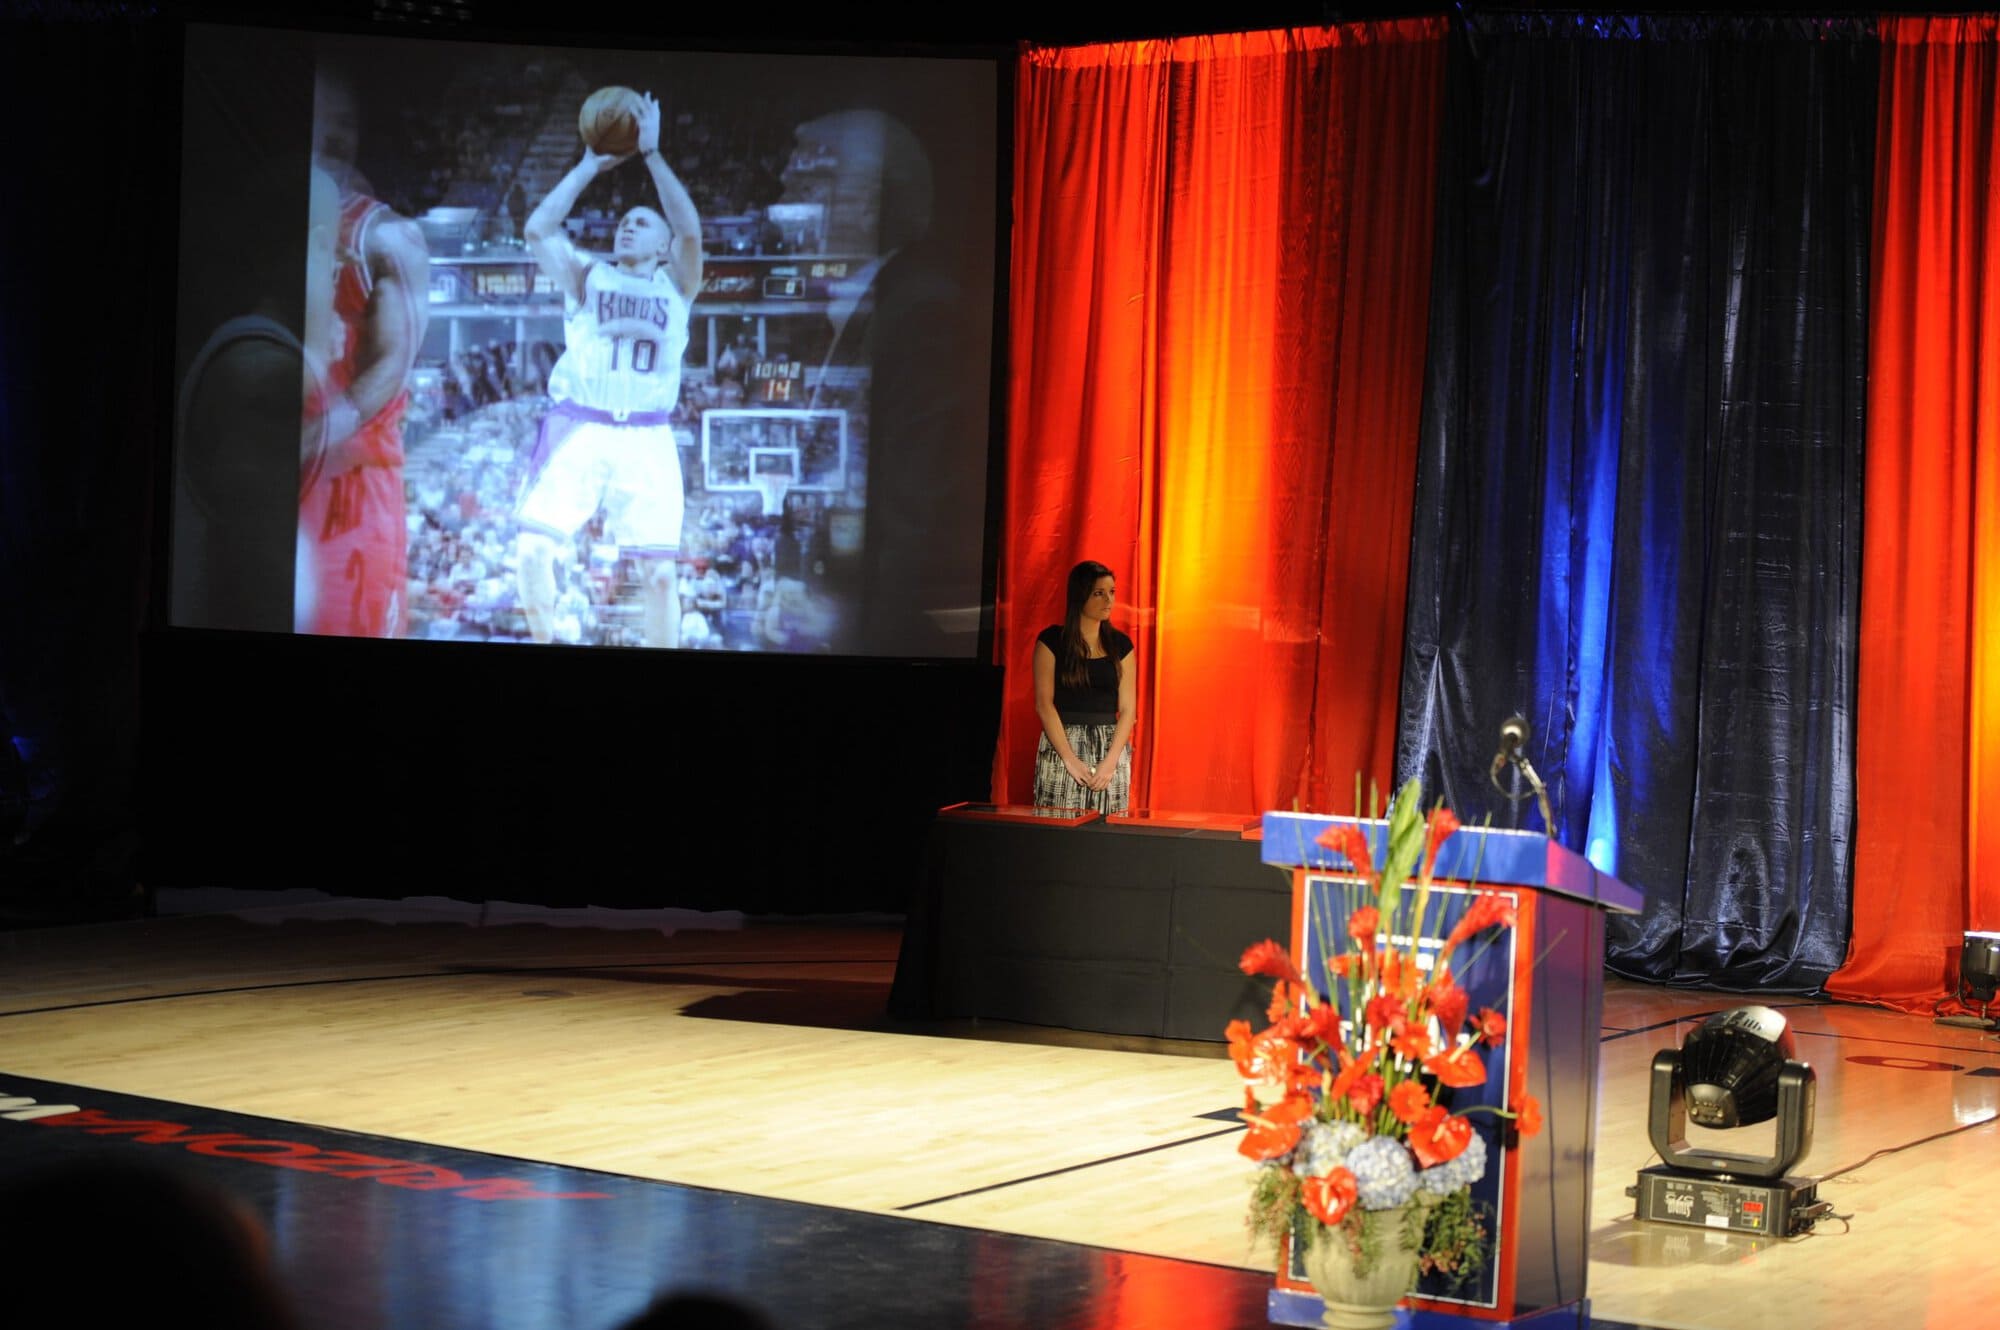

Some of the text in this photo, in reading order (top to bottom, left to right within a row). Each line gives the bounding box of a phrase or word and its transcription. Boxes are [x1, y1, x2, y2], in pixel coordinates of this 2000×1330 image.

[598, 290, 669, 330] KINGS
[611, 335, 657, 374] 10
[767, 379, 791, 401] 14
